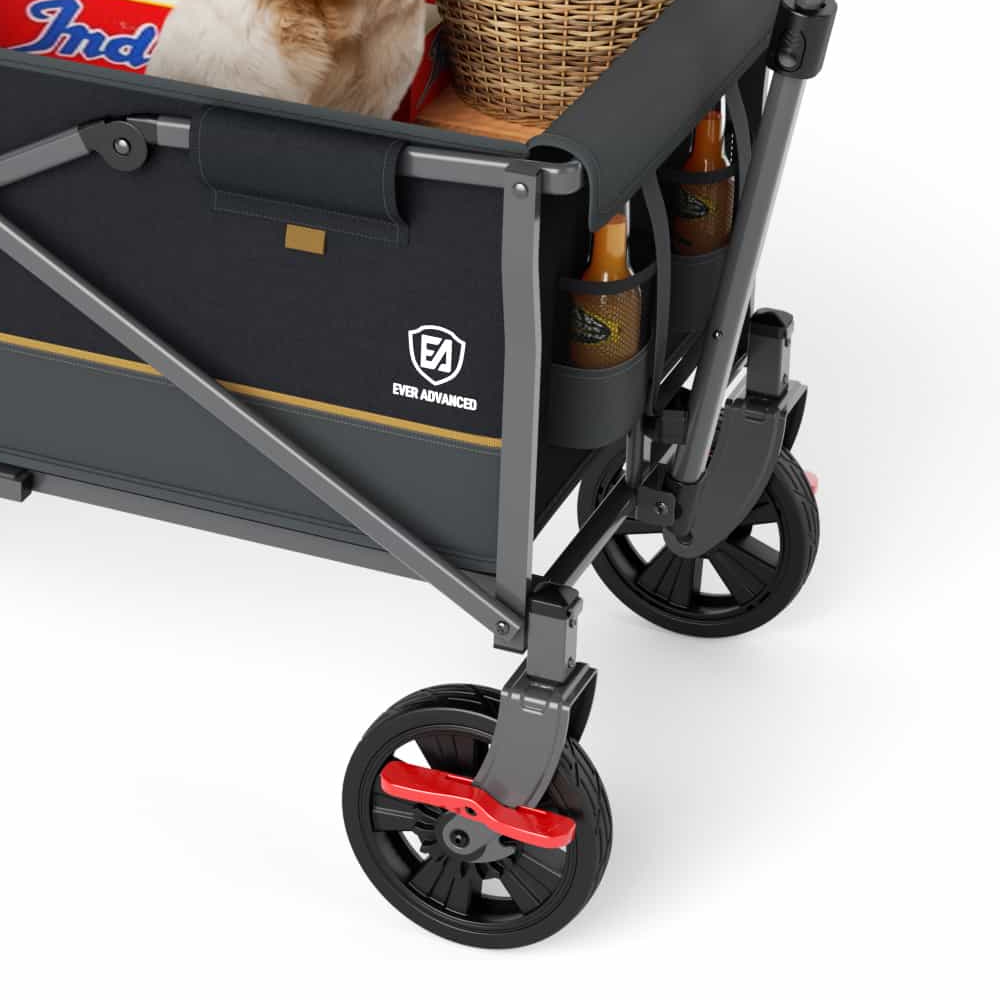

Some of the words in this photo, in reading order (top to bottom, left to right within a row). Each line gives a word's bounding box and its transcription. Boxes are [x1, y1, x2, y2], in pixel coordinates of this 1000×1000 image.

[420, 334, 453, 374] EA
[392, 382, 419, 399] EVER
[420, 388, 478, 411] ADVANCED
